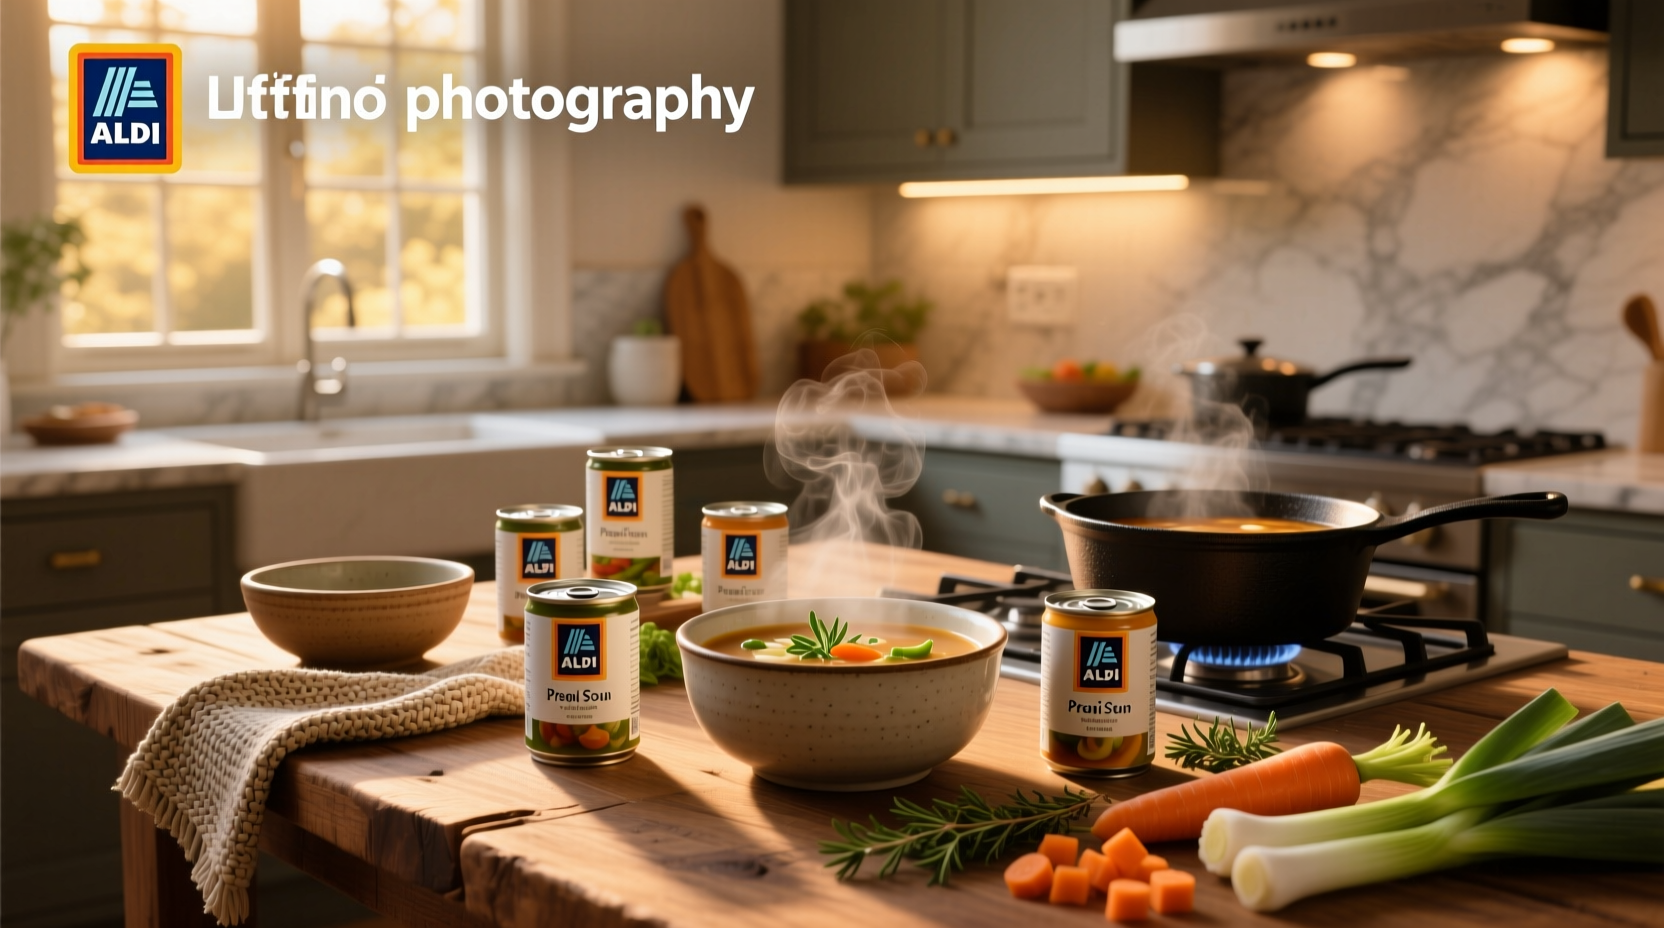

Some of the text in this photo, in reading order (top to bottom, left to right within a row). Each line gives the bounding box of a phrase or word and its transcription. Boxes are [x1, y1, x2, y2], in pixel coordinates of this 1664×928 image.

[608, 501, 637, 513] ALDI
[727, 560, 755, 571] ALDI
[561, 656, 597, 669] ALDI
[1083, 668, 1120, 681] ALDI
